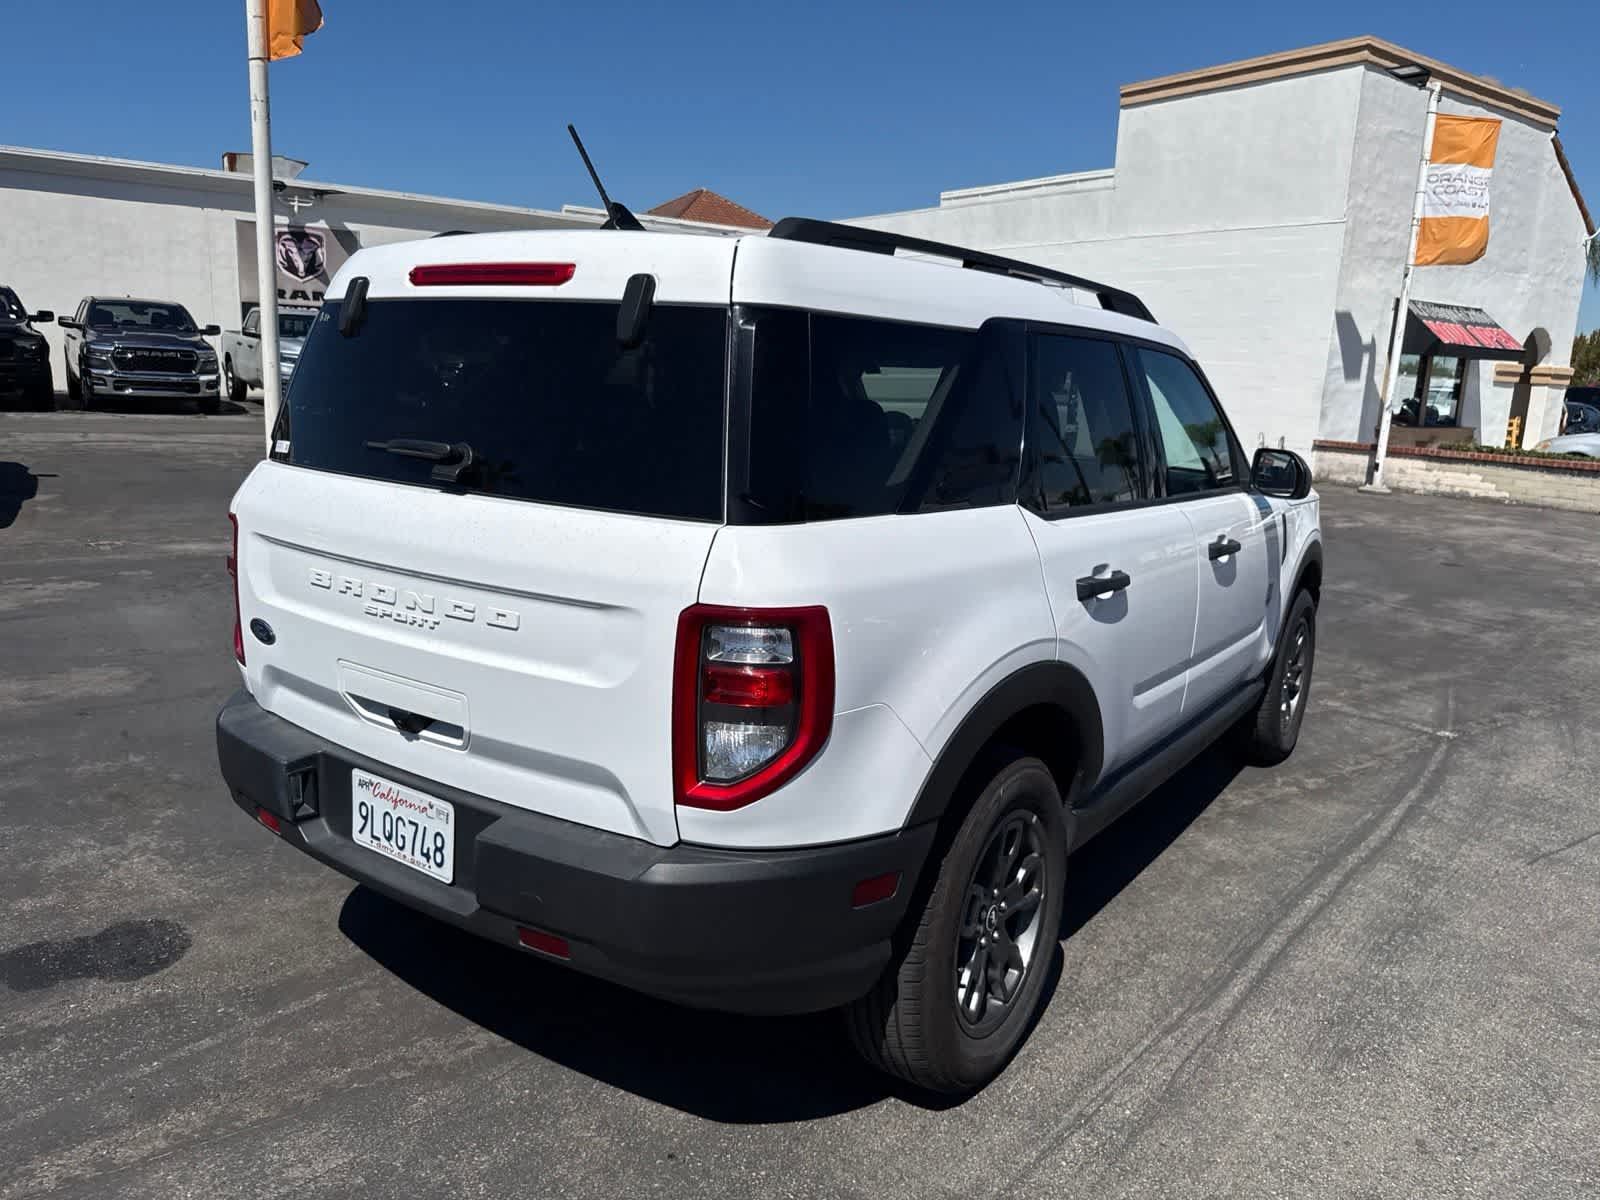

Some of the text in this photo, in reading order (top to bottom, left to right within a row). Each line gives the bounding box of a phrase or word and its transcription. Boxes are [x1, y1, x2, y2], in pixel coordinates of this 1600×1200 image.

[1433, 185, 1486, 197] COAST
[308, 568, 521, 632] BRONCO
[363, 603, 441, 631] SPORT
[372, 782, 434, 819] California
[358, 800, 445, 868] 9LQG748
